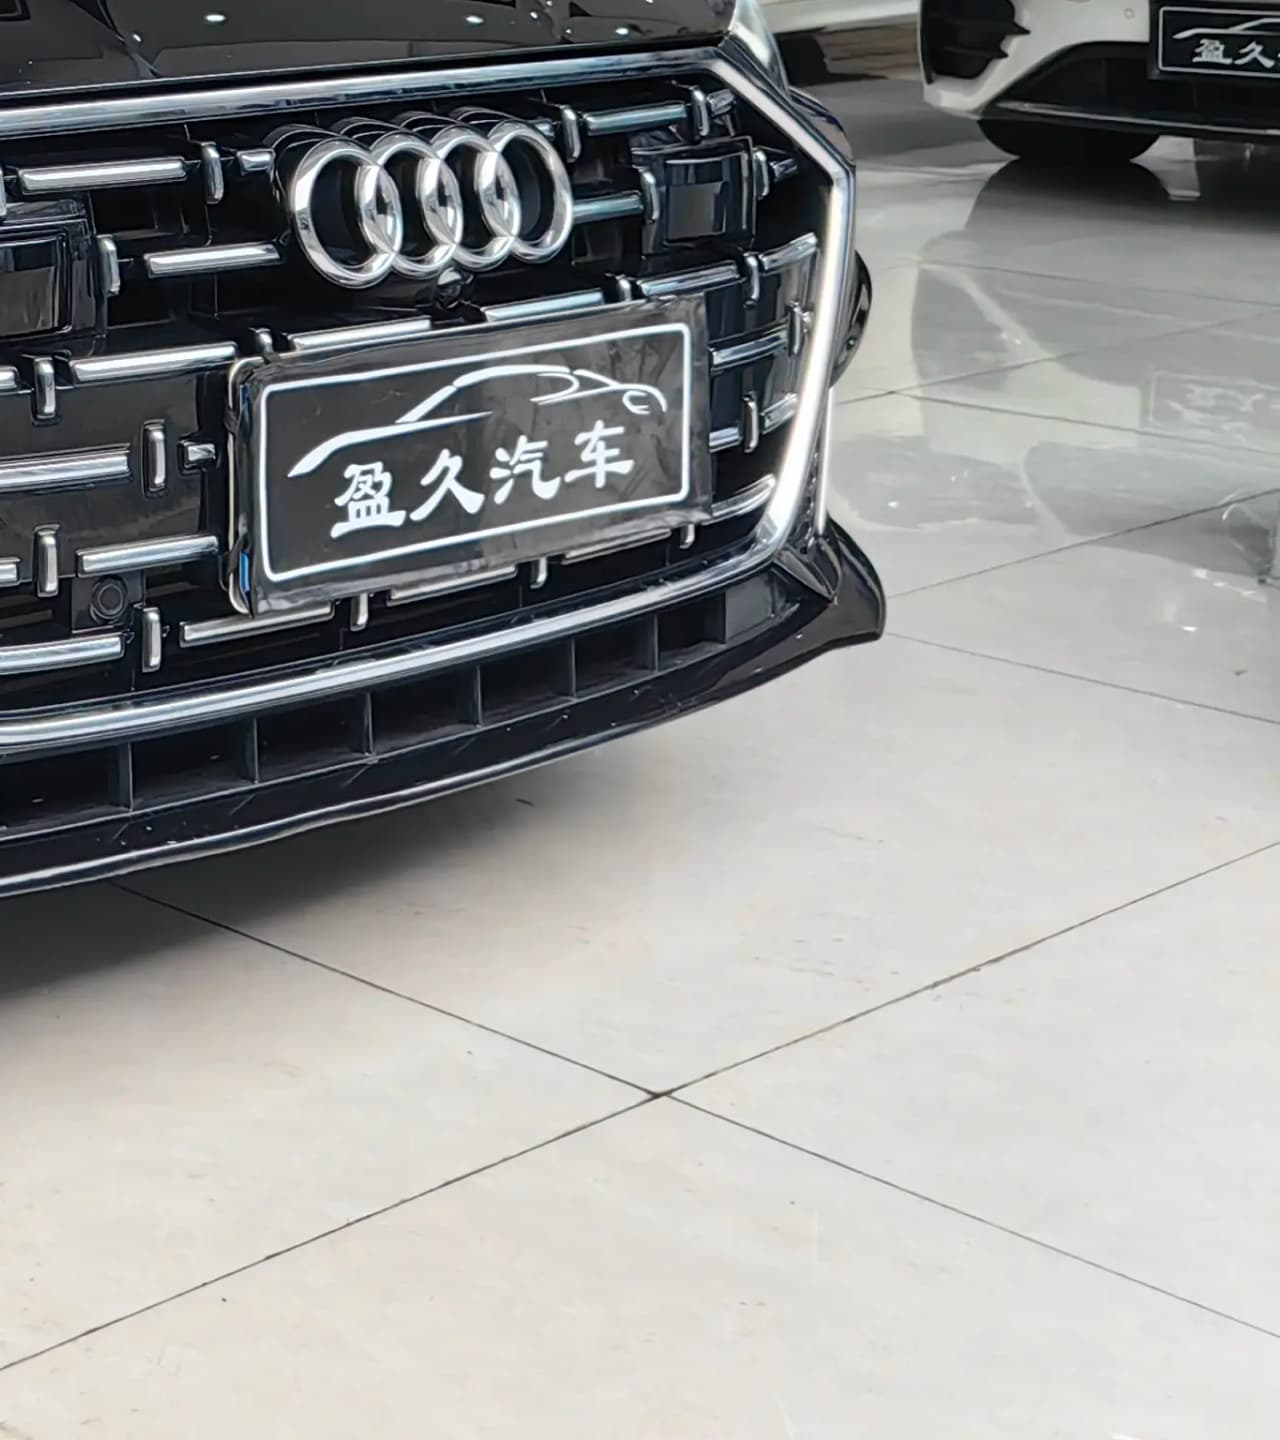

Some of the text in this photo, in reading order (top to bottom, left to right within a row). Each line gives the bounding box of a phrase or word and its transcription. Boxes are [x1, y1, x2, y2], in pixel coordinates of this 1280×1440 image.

[1192, 38, 1280, 69] 盈久
[330, 419, 635, 539] 盈久汽车
